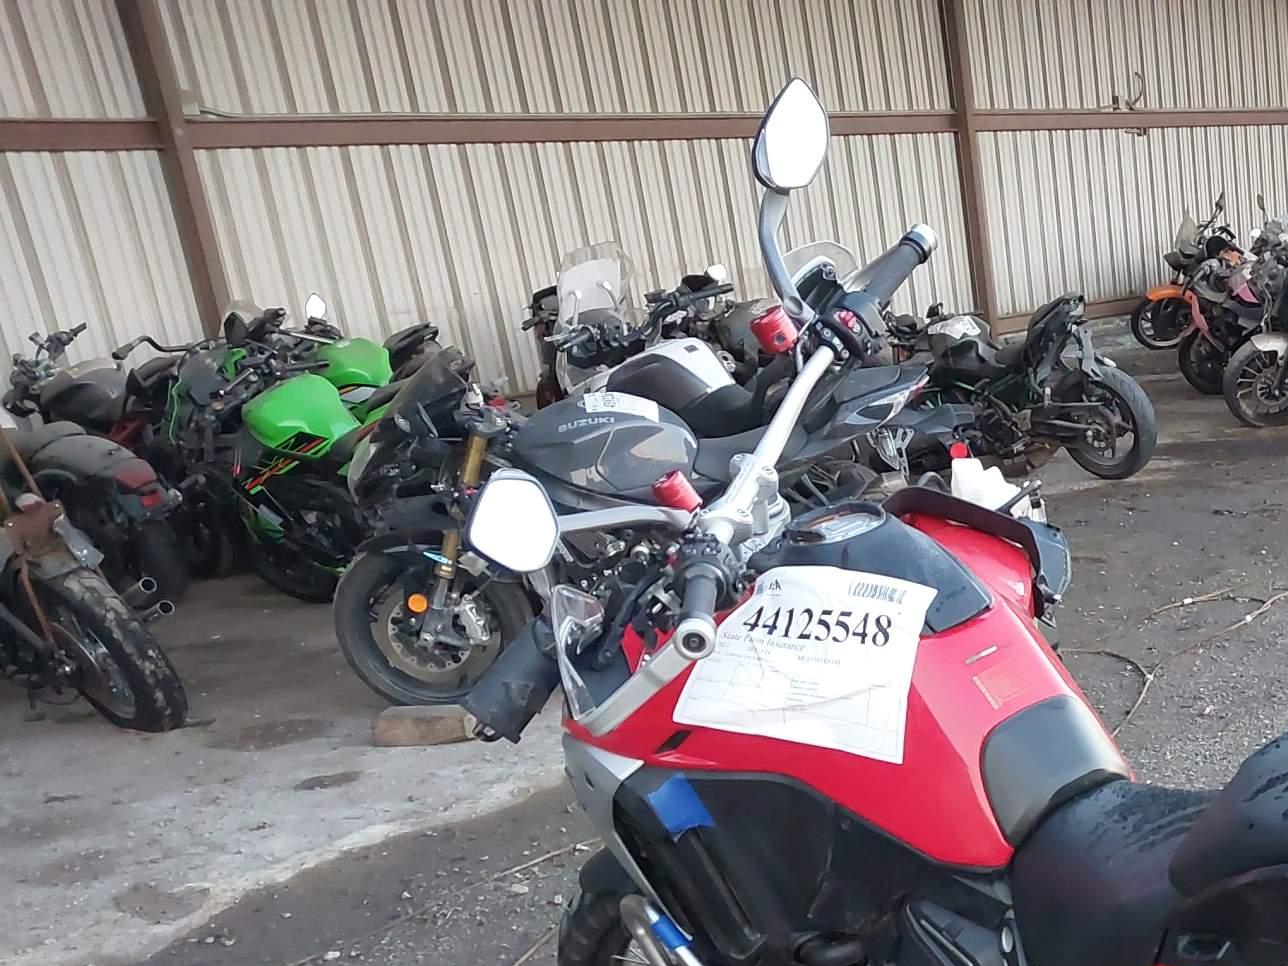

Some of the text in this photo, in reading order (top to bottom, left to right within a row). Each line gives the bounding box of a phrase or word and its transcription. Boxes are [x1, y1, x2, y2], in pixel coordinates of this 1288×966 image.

[558, 416, 615, 432] SUZUKI
[743, 605, 892, 647] 44125548
[720, 631, 743, 642] State
[766, 638, 806, 652] Insurance
